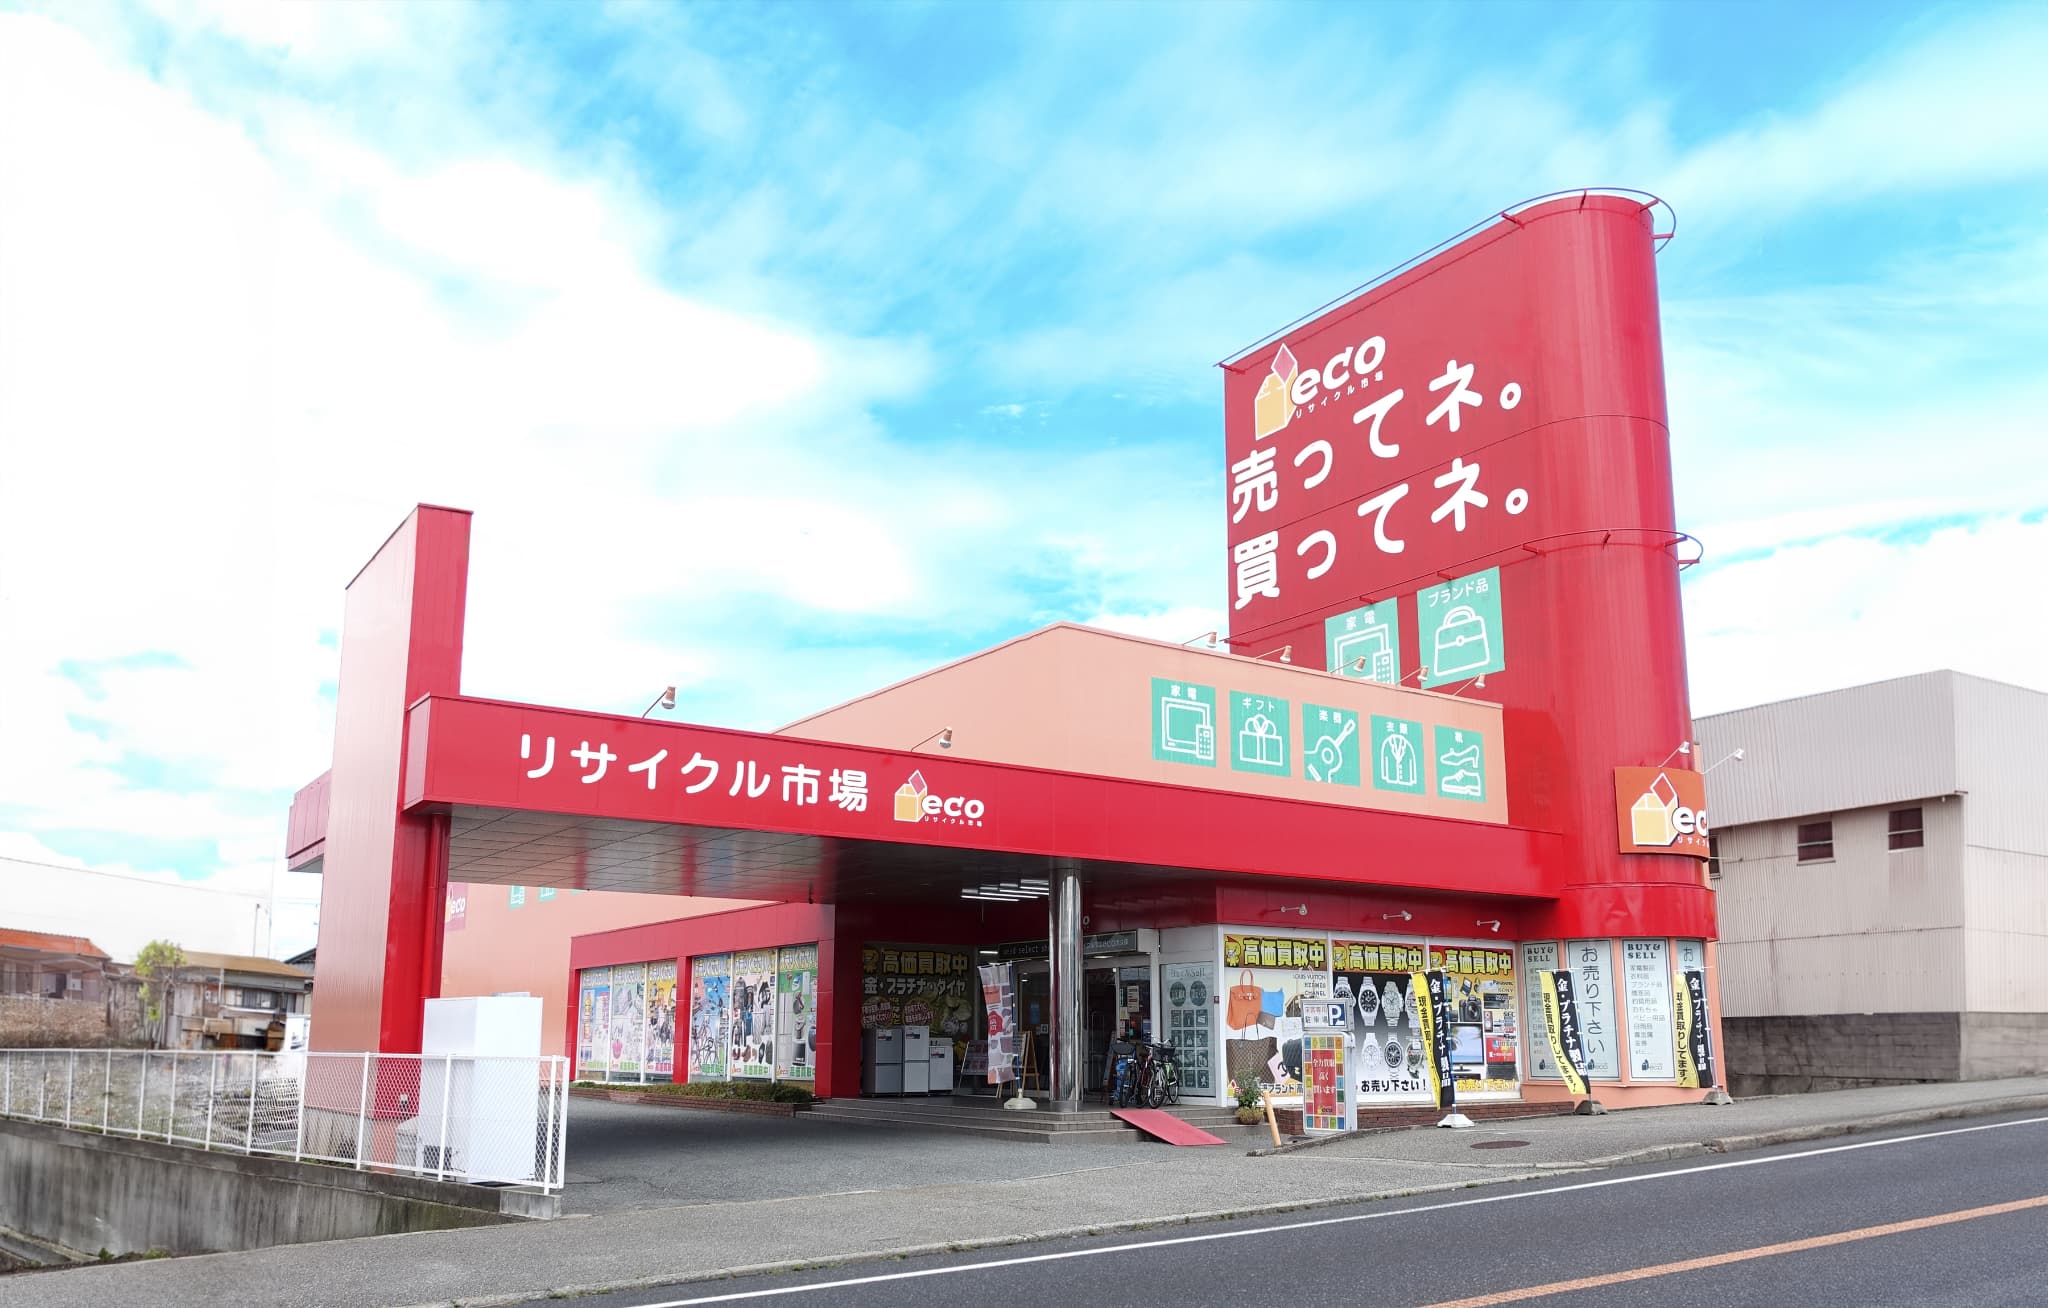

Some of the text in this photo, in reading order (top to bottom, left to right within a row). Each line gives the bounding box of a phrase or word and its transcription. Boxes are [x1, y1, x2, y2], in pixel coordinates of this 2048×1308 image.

[1291, 336, 1386, 405] eco
[1231, 359, 1522, 524] 売ってネ。
[1234, 457, 1529, 610] 買ってネ。
[1428, 577, 1489, 607] ブランド品
[1242, 697, 1275, 713] ギフト
[520, 733, 869, 813] リサイクル市場
[921, 794, 984, 819] eco
[882, 949, 968, 977] 高価買取中
[1243, 937, 1326, 969] 高価買取中
[1348, 943, 1424, 972] 高価買取中
[1446, 948, 1511, 975] 高価買取中
[1527, 955, 1551, 963] SELL
[1627, 952, 1656, 960] SELL
[1581, 946, 1605, 1054] お売り下さい
